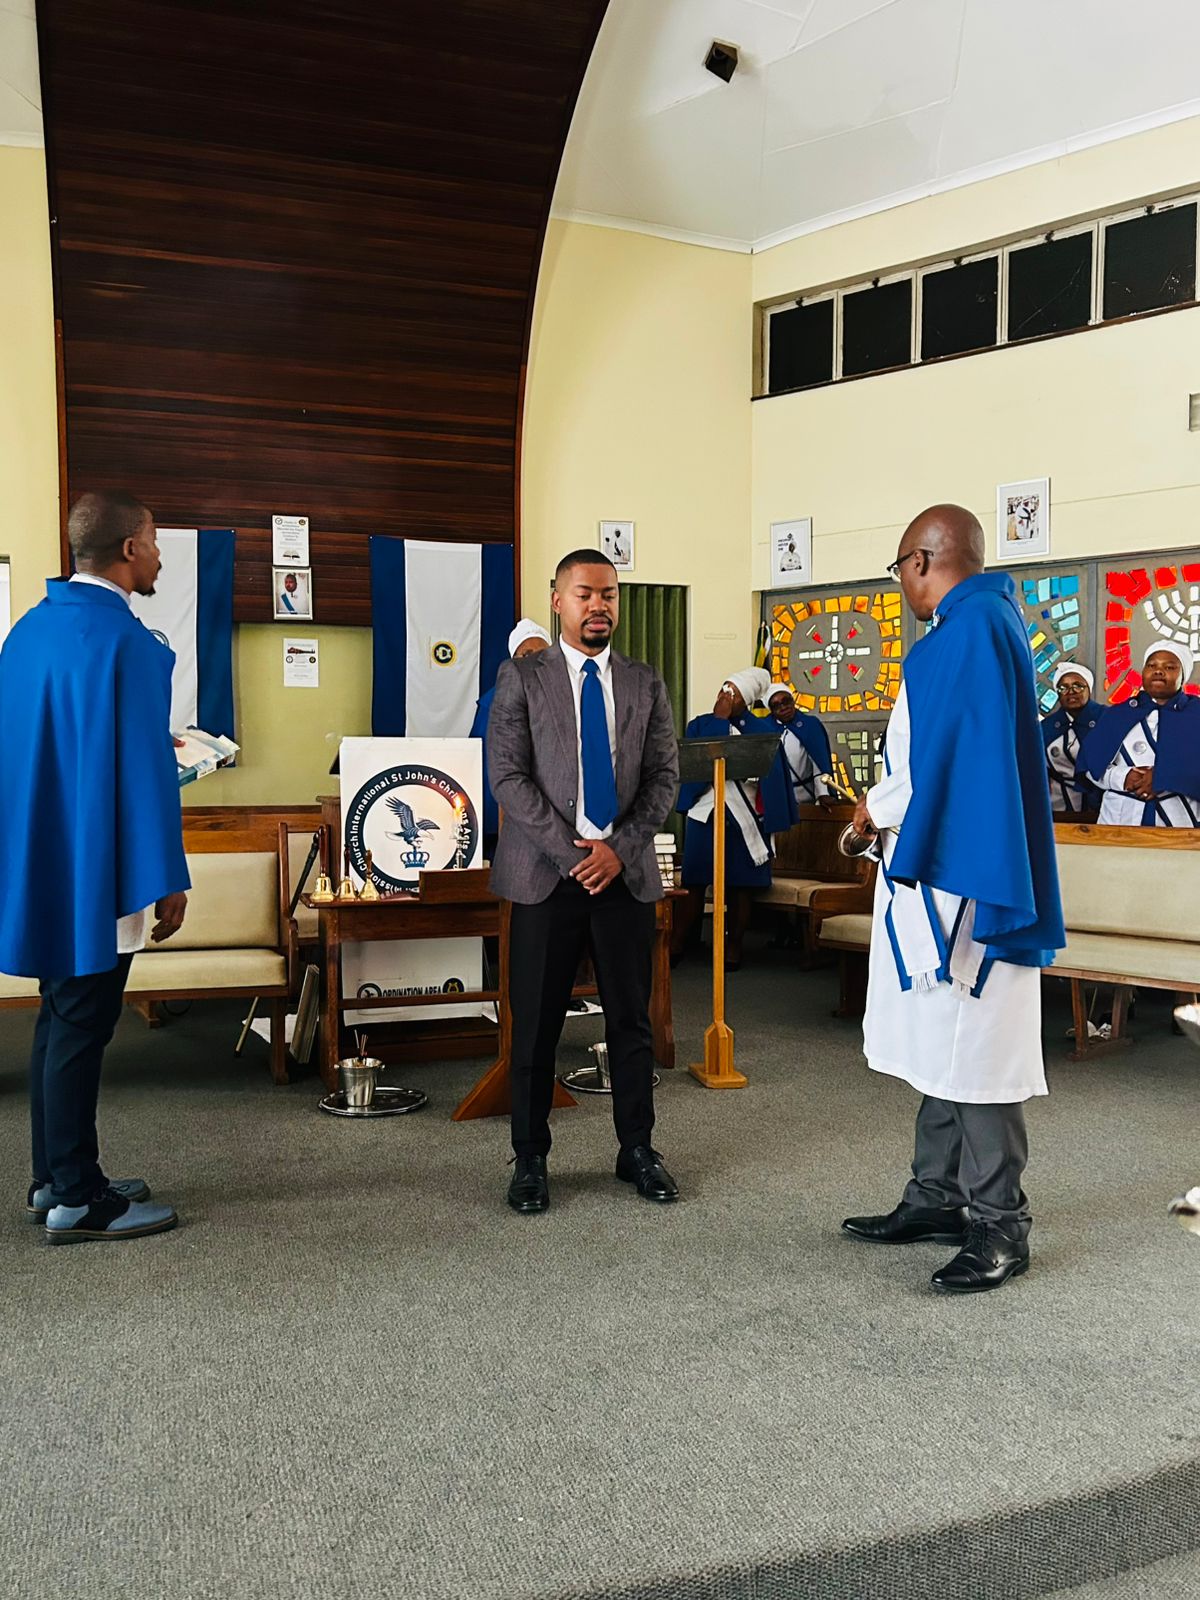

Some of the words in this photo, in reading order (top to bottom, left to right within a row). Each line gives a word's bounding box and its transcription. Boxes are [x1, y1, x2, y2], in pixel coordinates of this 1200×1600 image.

[392, 773, 403, 782] St
[405, 771, 437, 784] John's
[351, 777, 390, 834] International
[350, 835, 367, 872] Church
